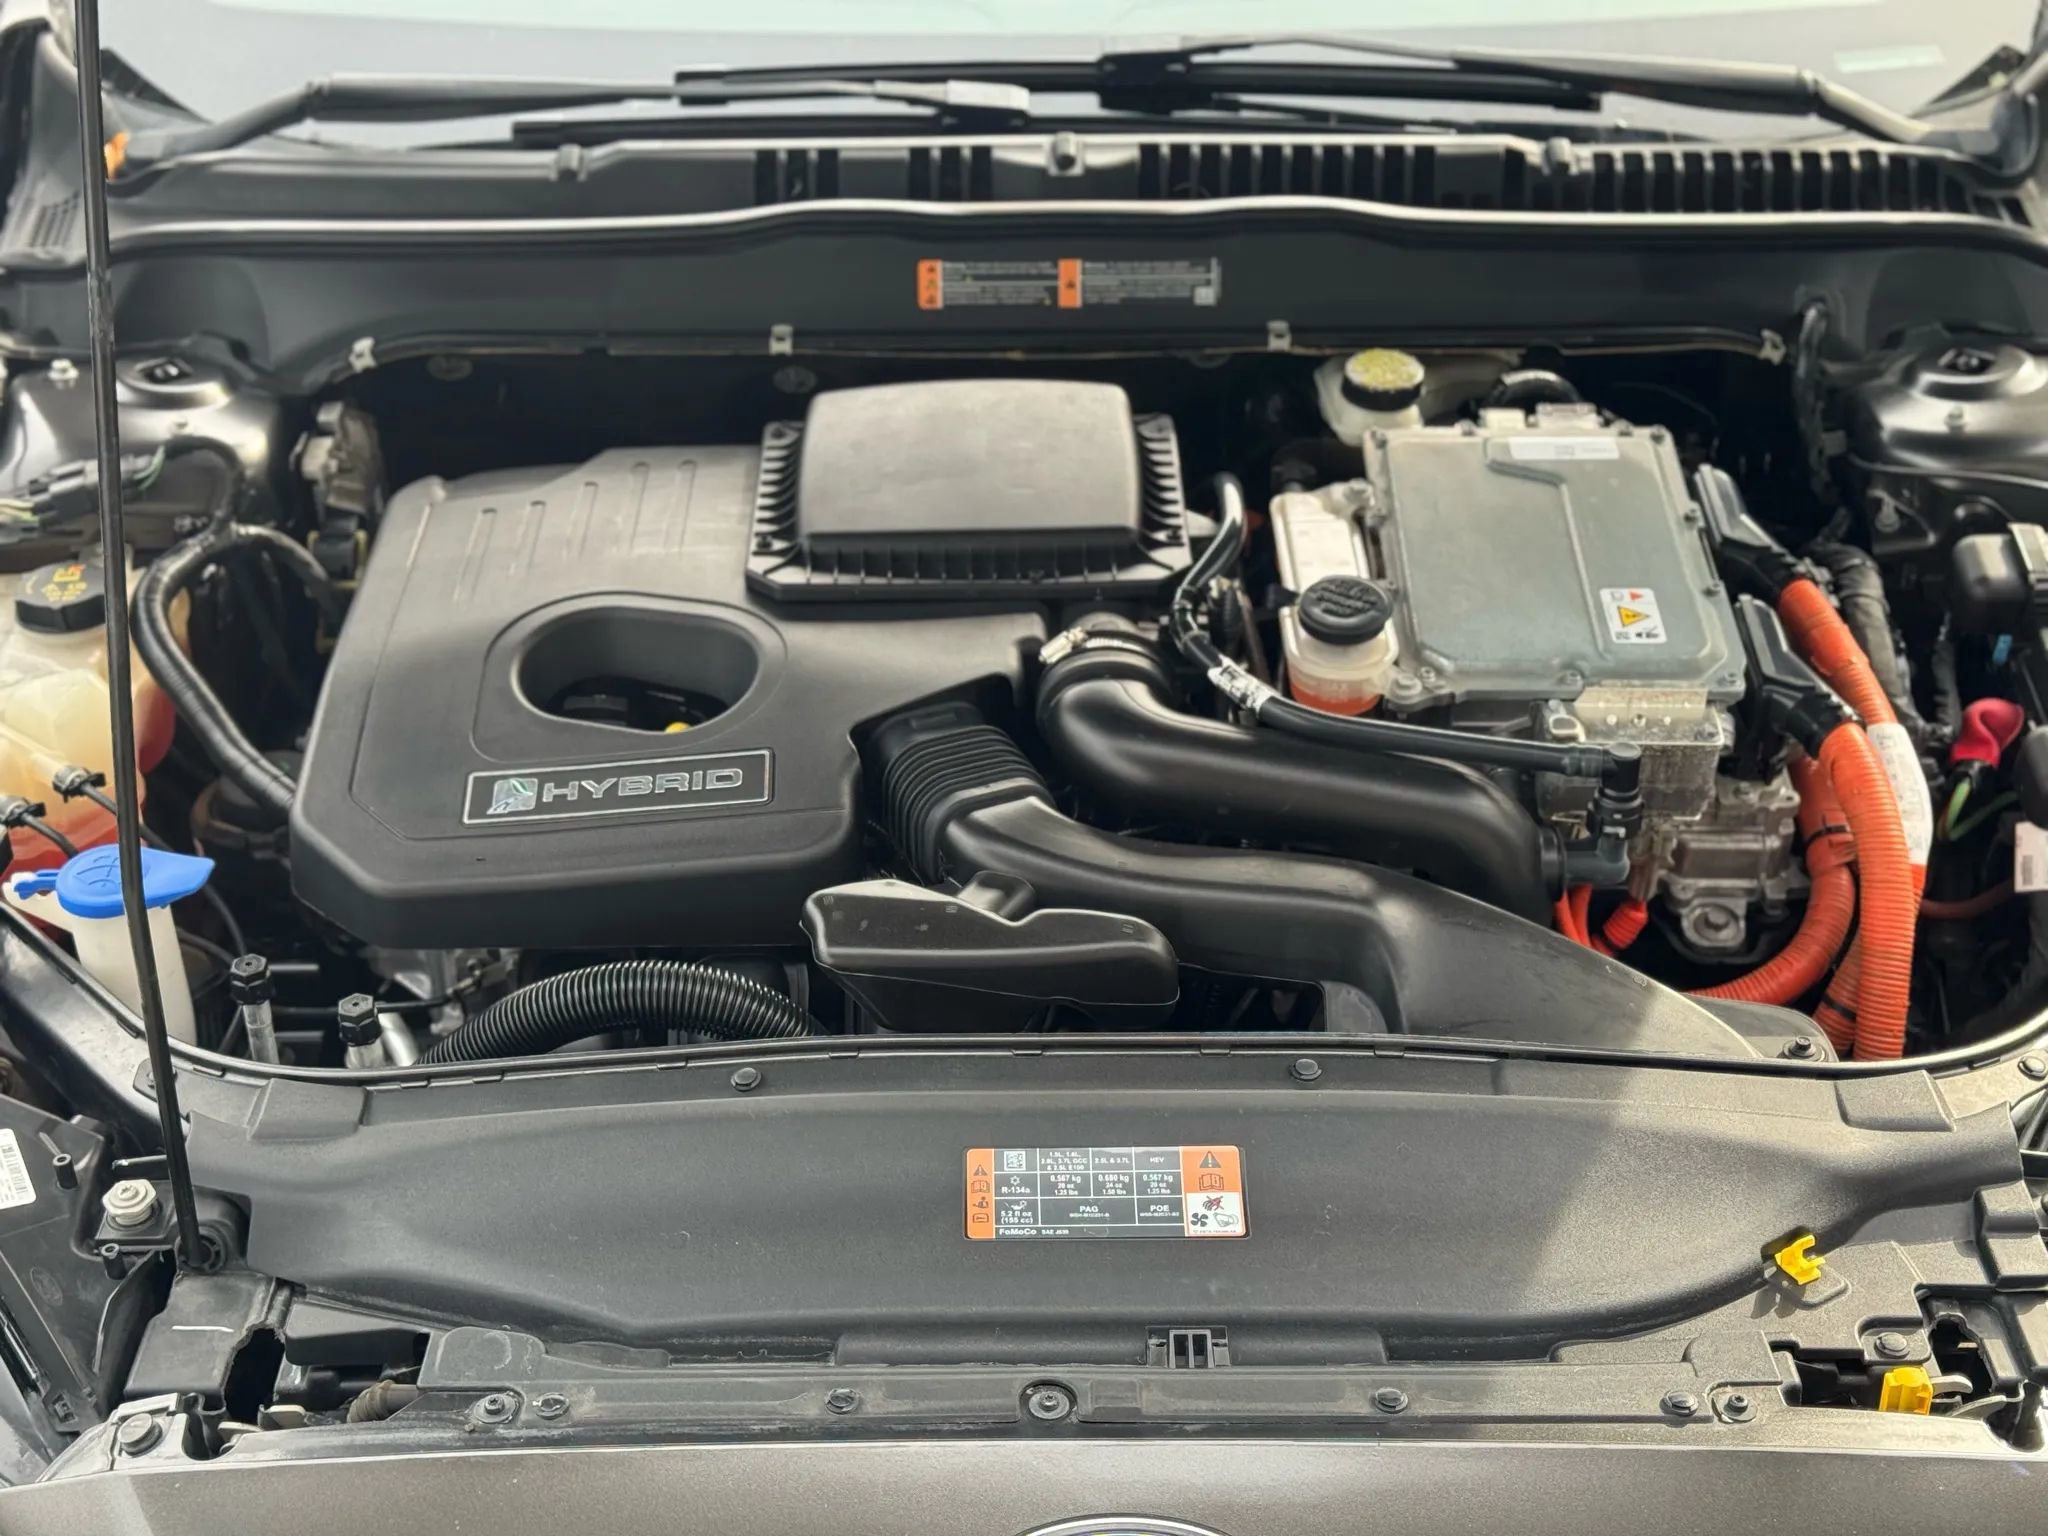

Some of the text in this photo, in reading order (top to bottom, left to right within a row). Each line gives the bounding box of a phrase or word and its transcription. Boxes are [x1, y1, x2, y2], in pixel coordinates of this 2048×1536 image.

[543, 768, 743, 802] HYBRID
[1050, 1174, 1081, 1183] 0.567 kg
[1119, 1174, 1130, 1183] kg
[1163, 1174, 1173, 1182] kg
[1001, 1186, 1031, 1194] R-134a
[1079, 1205, 1099, 1213] PAG
